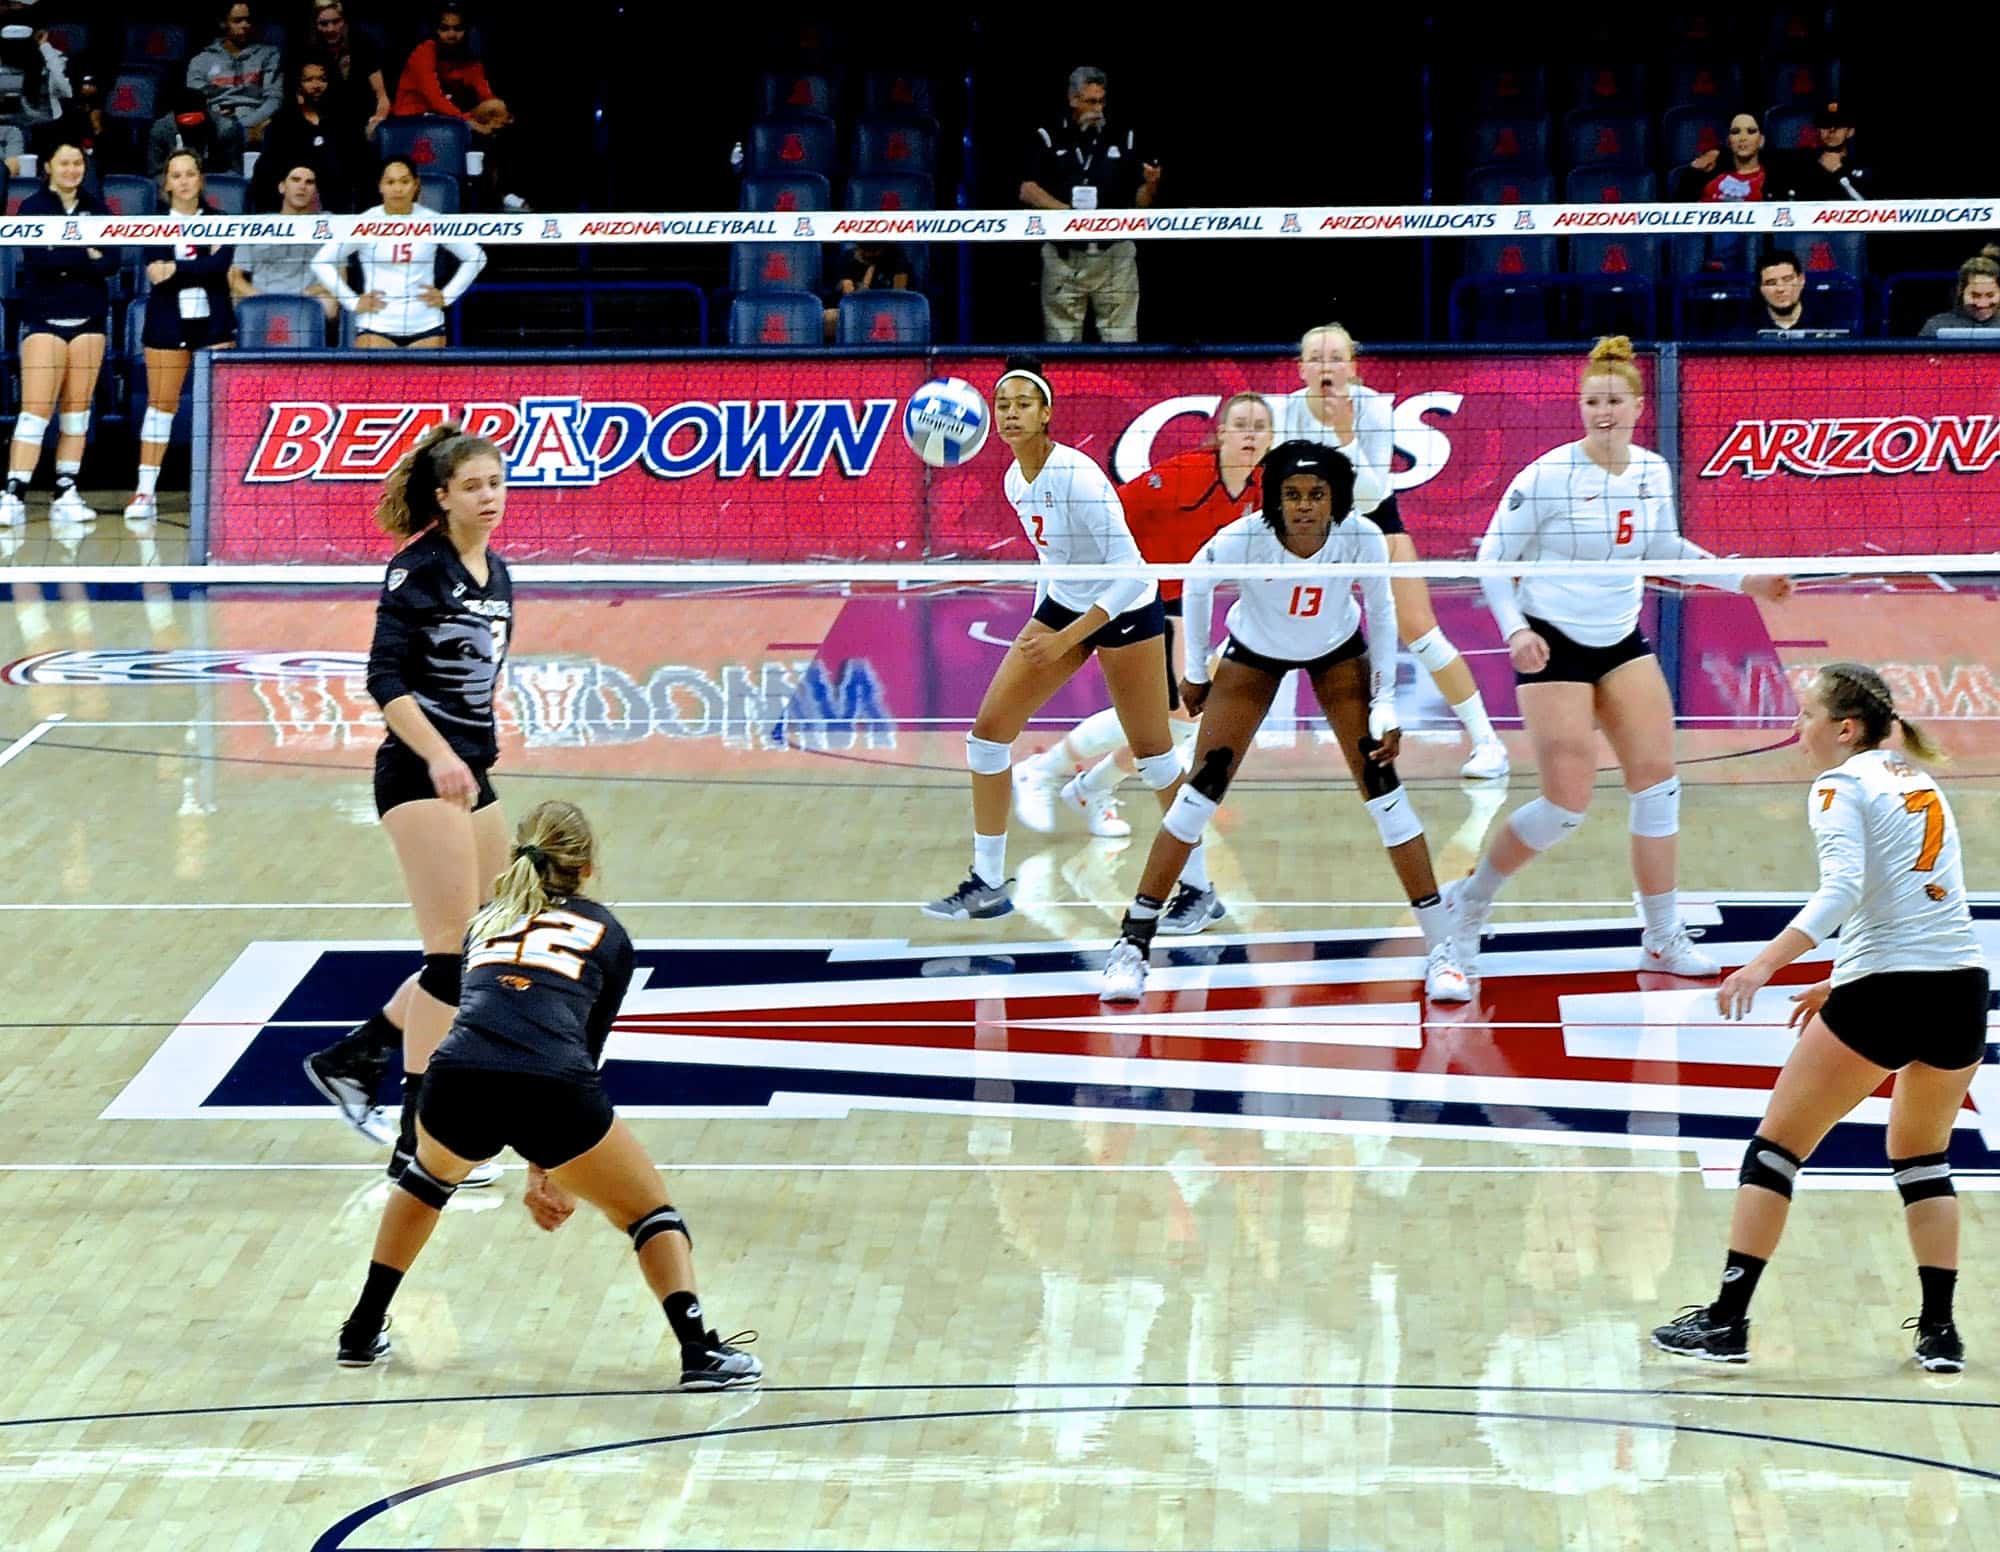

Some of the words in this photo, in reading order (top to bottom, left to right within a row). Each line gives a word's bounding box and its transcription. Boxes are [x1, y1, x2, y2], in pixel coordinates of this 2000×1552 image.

[391, 242, 413, 264] 15
[583, 398, 898, 478] DOWN
[1700, 415, 2000, 477] ARIZON
[1031, 515, 1048, 547] 2
[1616, 509, 1634, 545] 6
[1288, 584, 1324, 617] 13
[1817, 788, 1837, 812] 7
[1902, 788, 1946, 872] 7
